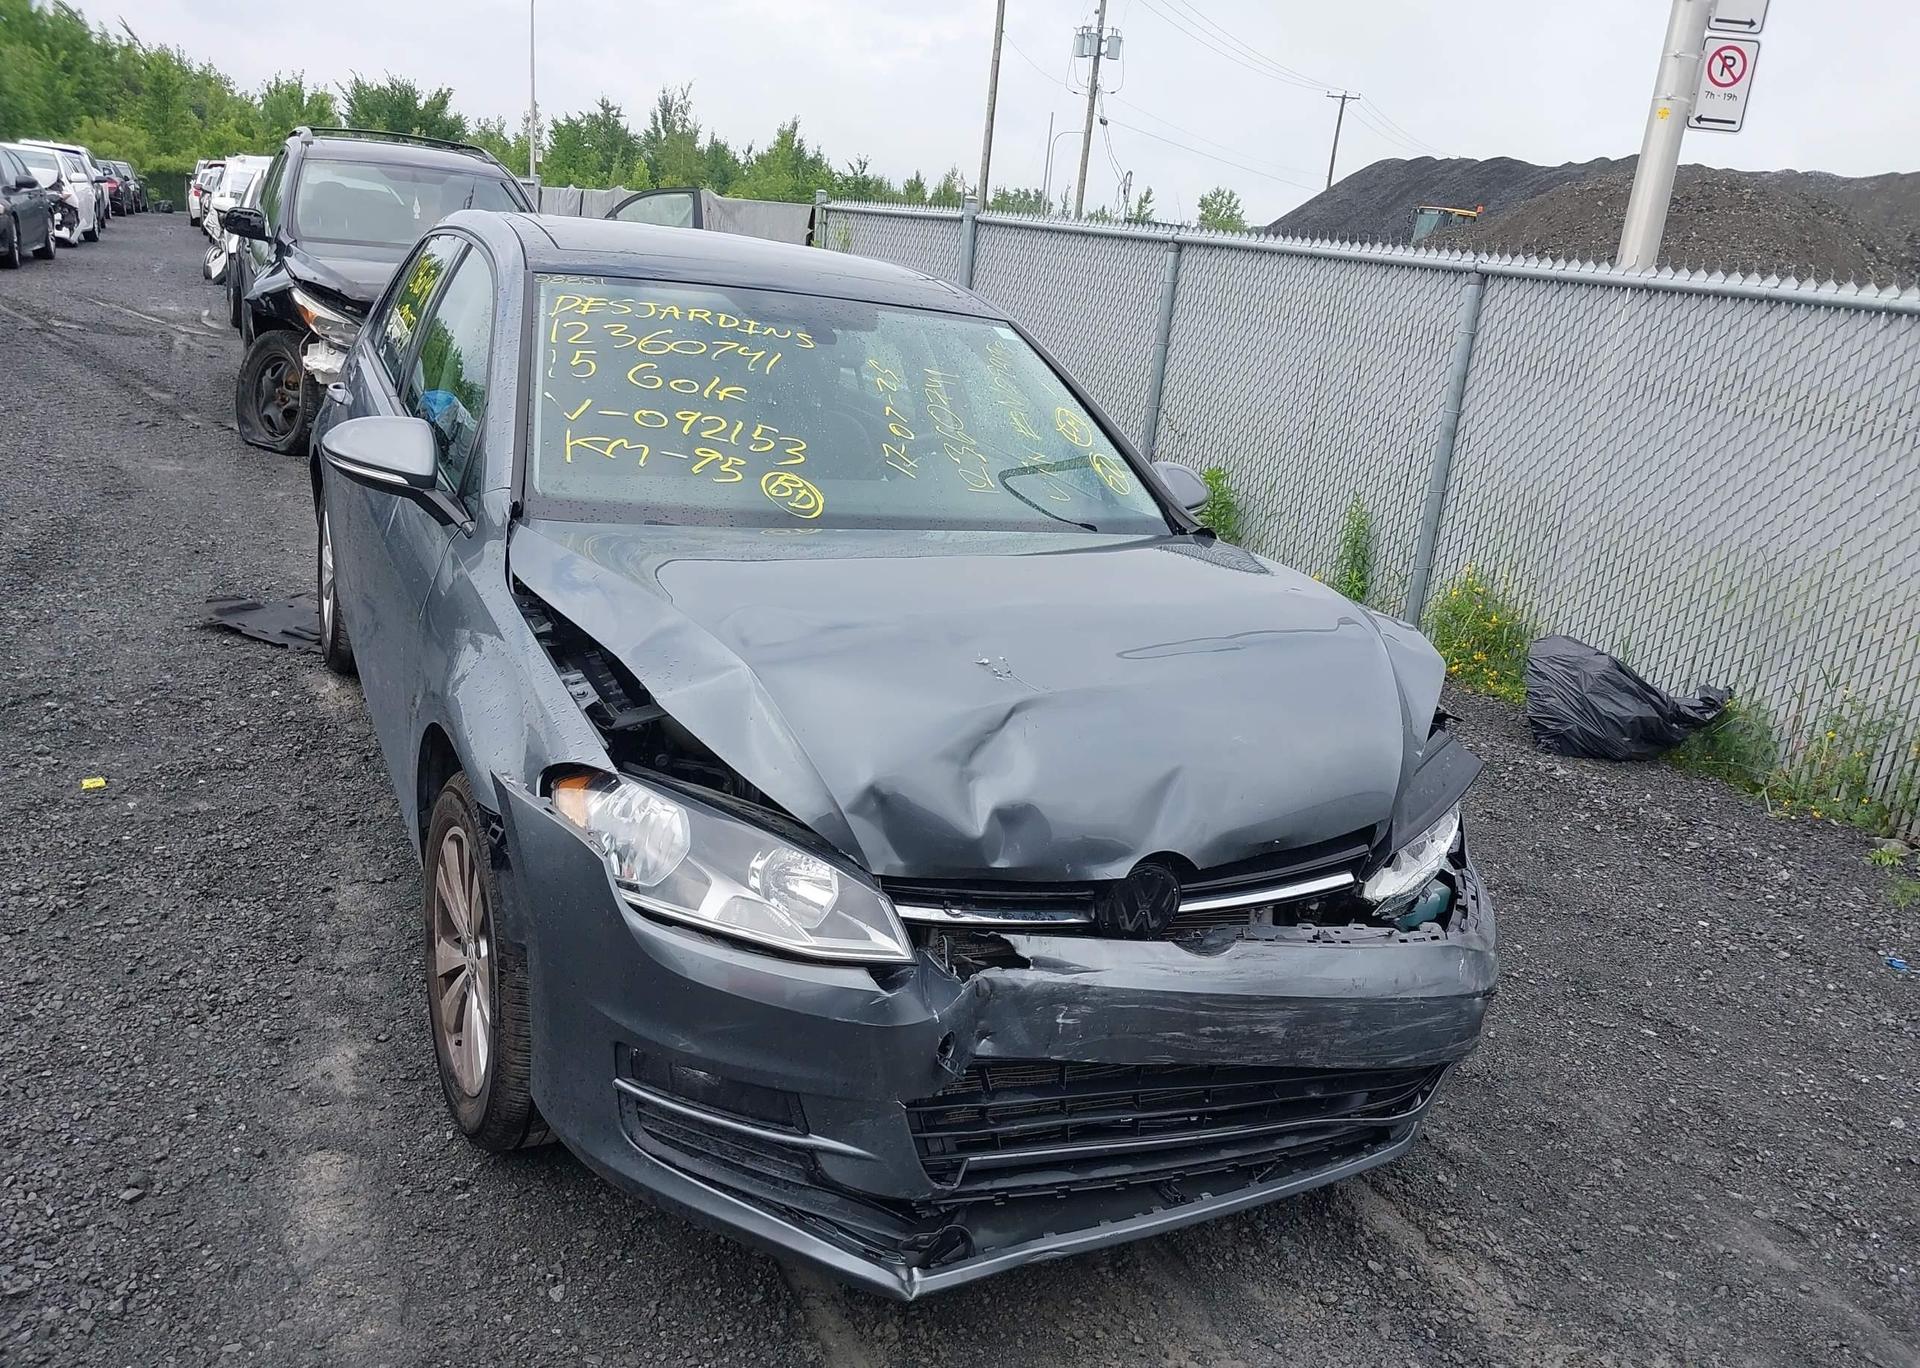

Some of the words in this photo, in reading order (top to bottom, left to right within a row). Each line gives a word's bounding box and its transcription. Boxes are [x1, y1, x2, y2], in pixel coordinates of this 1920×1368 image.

[1704, 91, 1715, 100] 7h
[1723, 92, 1738, 101] 19h
[549, 295, 815, 349] DESJARDINS
